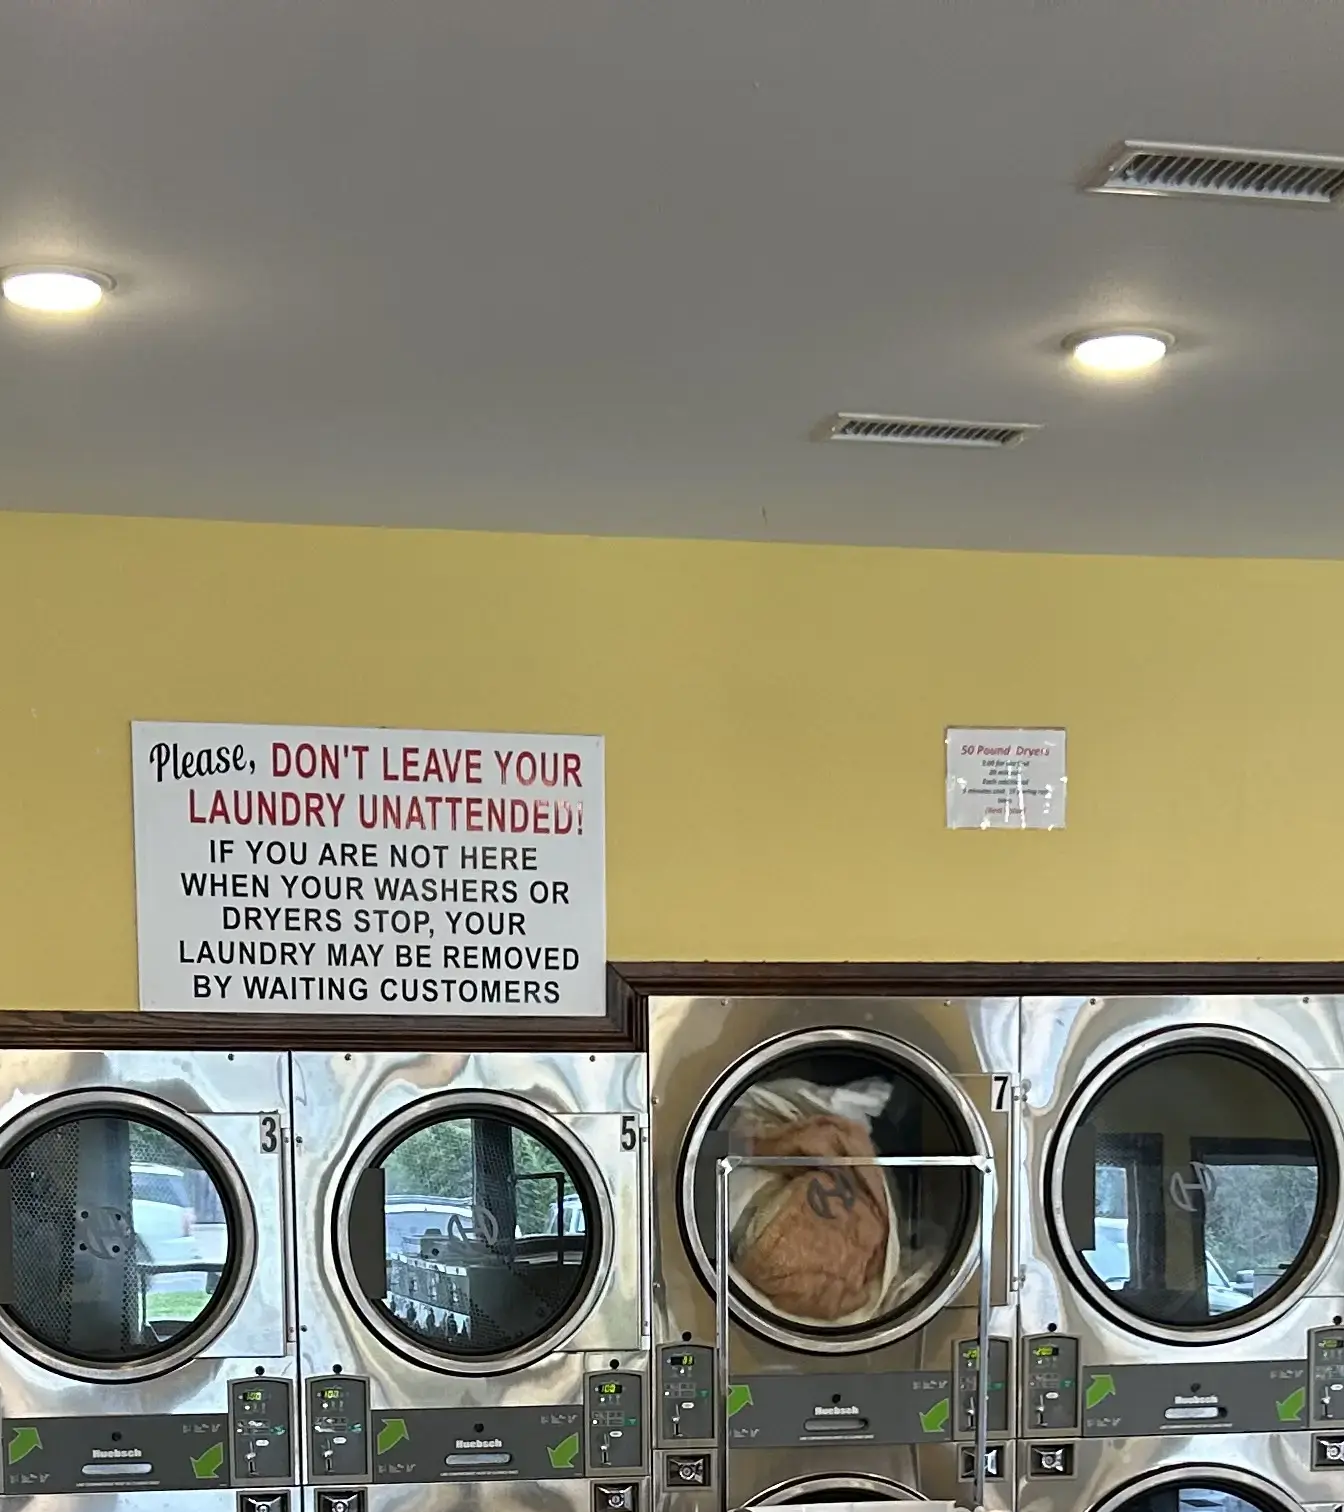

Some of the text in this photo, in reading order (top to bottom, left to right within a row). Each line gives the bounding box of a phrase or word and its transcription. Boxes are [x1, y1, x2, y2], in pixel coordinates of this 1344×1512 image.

[149, 742, 583, 787] Please, DON'T LEAVE YOUR
[960, 745, 974, 755] 50
[977, 745, 1011, 756] Pound
[188, 789, 584, 835] LAUNDRY UNATTENDED!
[210, 840, 538, 870] IF YOU ARE NOT HERE
[181, 873, 570, 904] WHEN YOUR WASHERS OR
[222, 907, 525, 938] DRYERS STOP, YOUR
[179, 940, 580, 971] LAUNDRY MAY BE REMOVED
[193, 975, 560, 1004] BY WAITING CUSTOMERS
[994, 1075, 1009, 1110] 7
[261, 1116, 278, 1153] 3
[621, 1115, 637, 1151] 5
